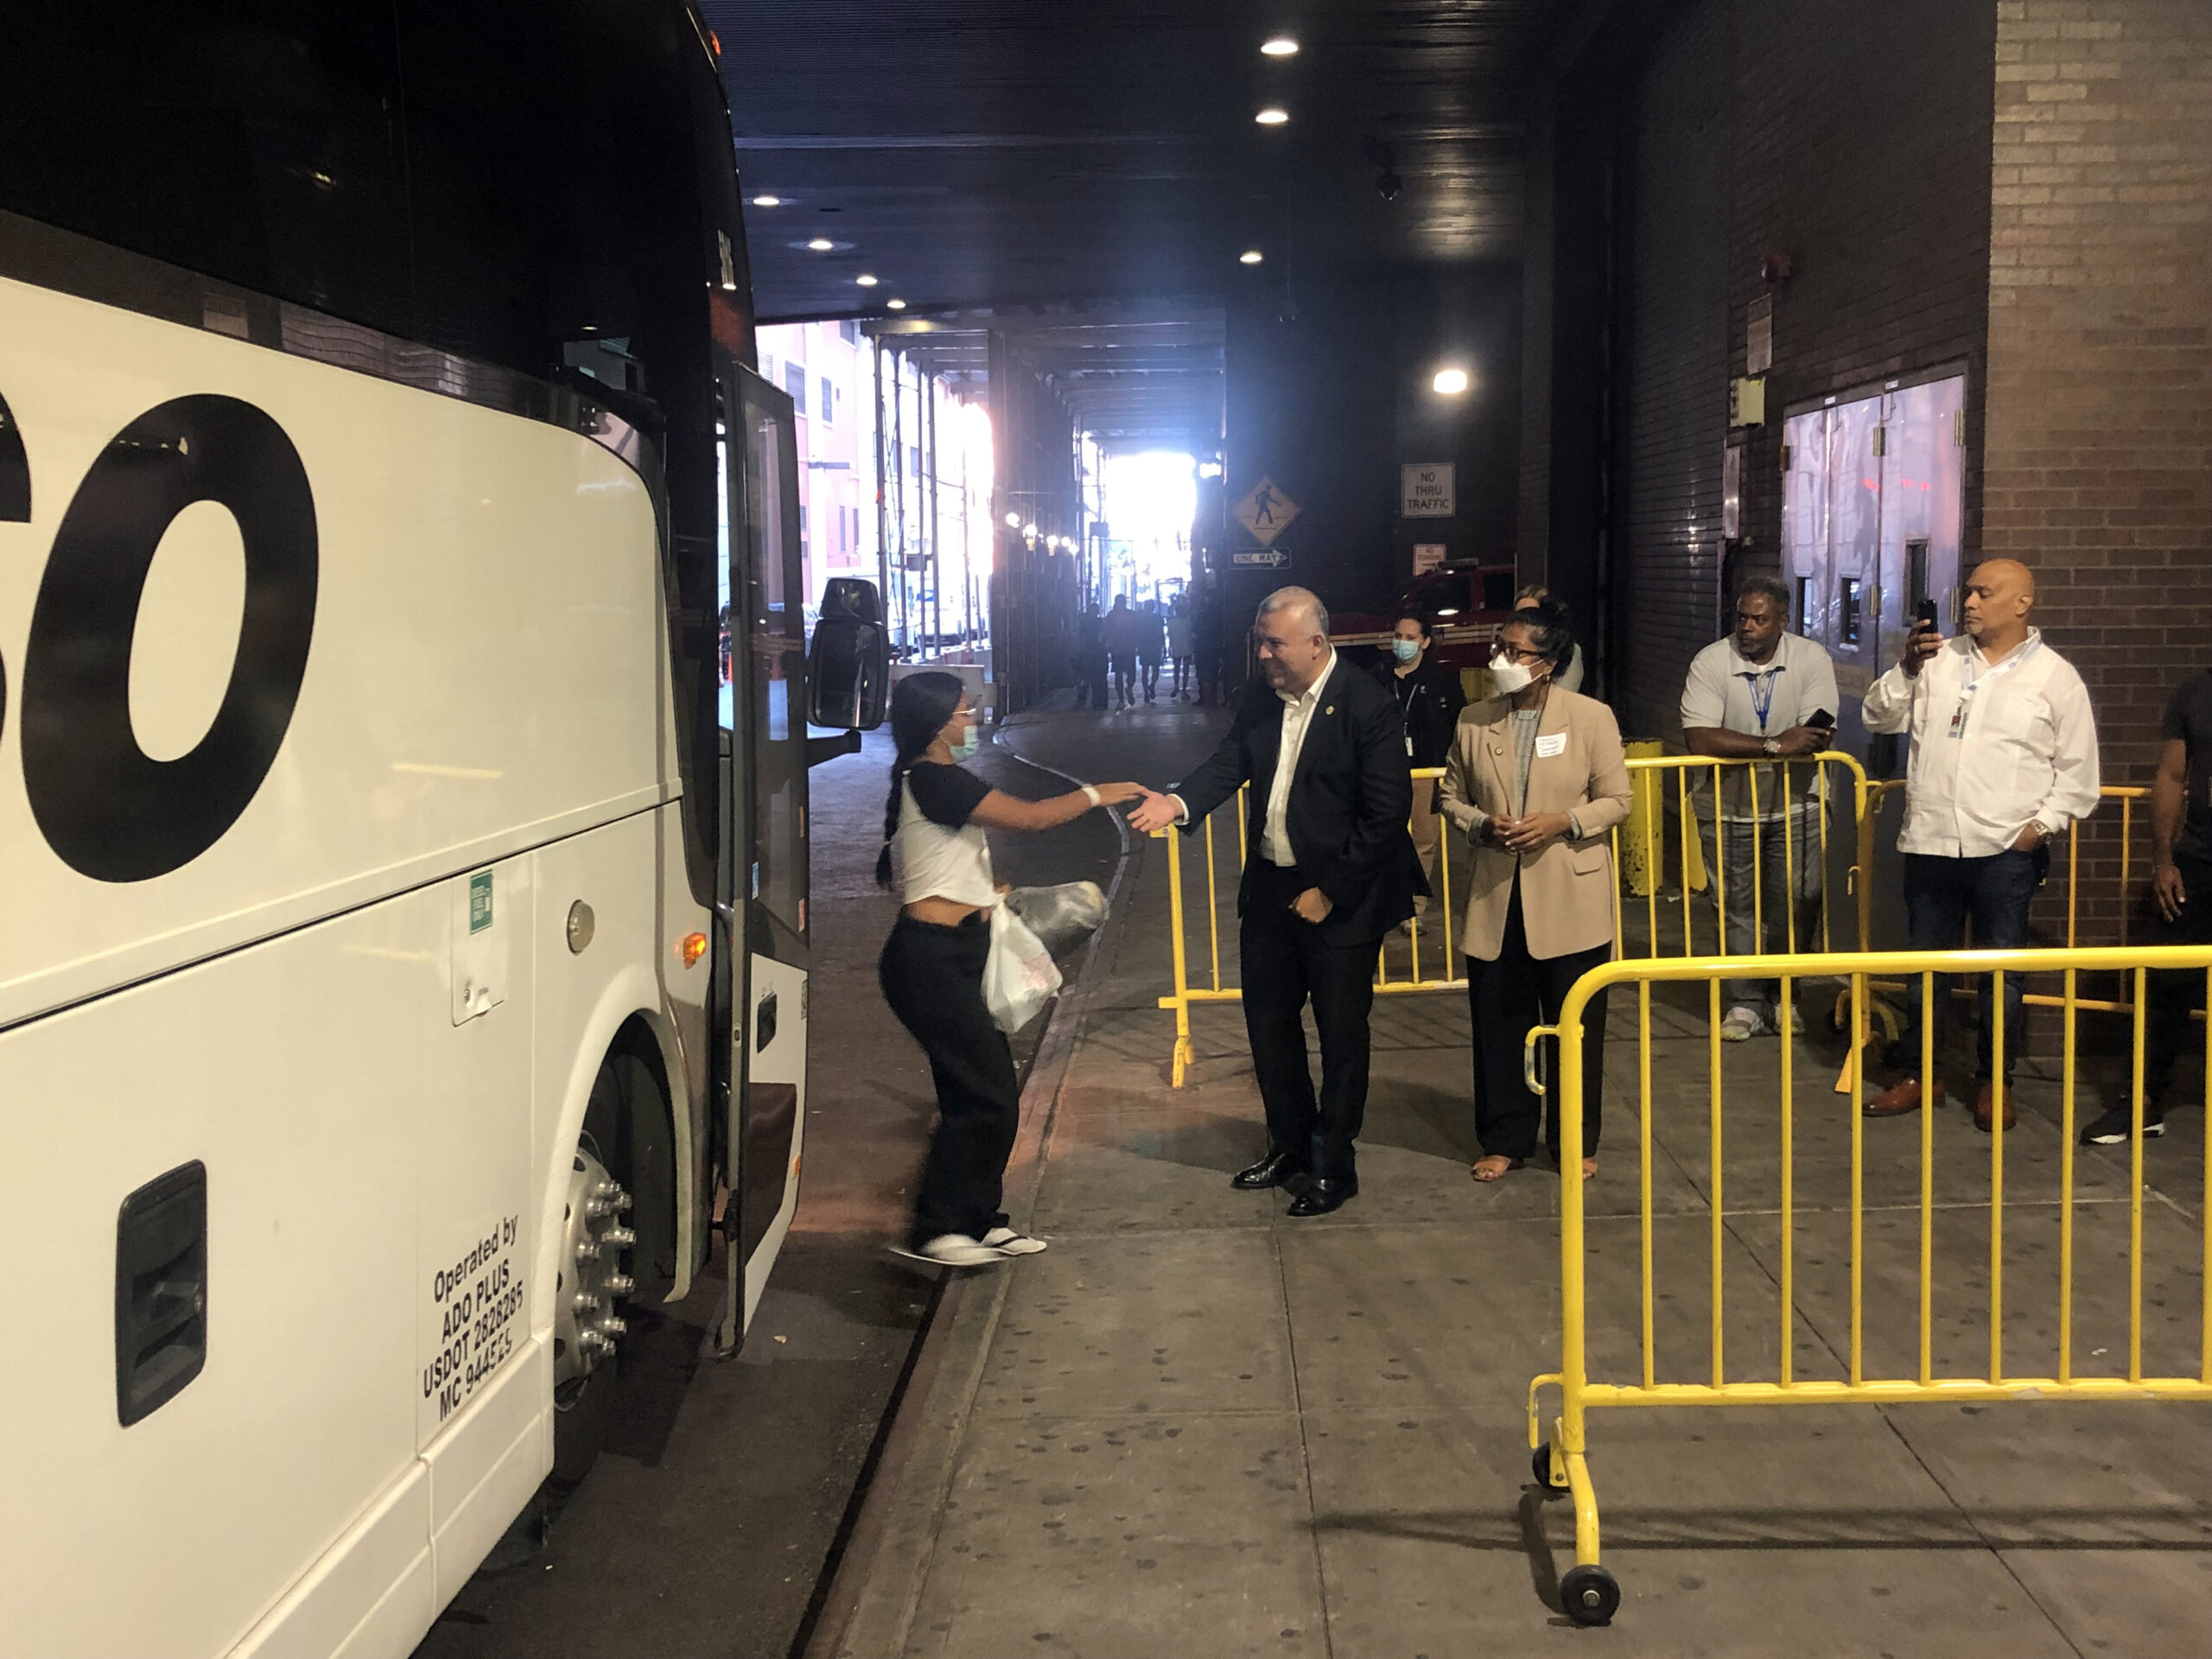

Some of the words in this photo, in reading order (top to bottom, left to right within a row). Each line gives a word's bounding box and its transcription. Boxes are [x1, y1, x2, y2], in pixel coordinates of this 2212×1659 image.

[1415, 485, 1442, 496] THRU
[1421, 472, 1435, 482] NO
[1407, 498, 1449, 510] TRAFFIC
[1259, 553, 1277, 562] WAY
[0, 391, 319, 883] O
[434, 1223, 499, 1303] Operated
[503, 1214, 518, 1247] by
[442, 1292, 472, 1344] ADO
[476, 1258, 510, 1313] PLUS
[423, 1329, 471, 1398] USDOT
[474, 1279, 524, 1352] 2828285
[439, 1376, 461, 1421] MC
